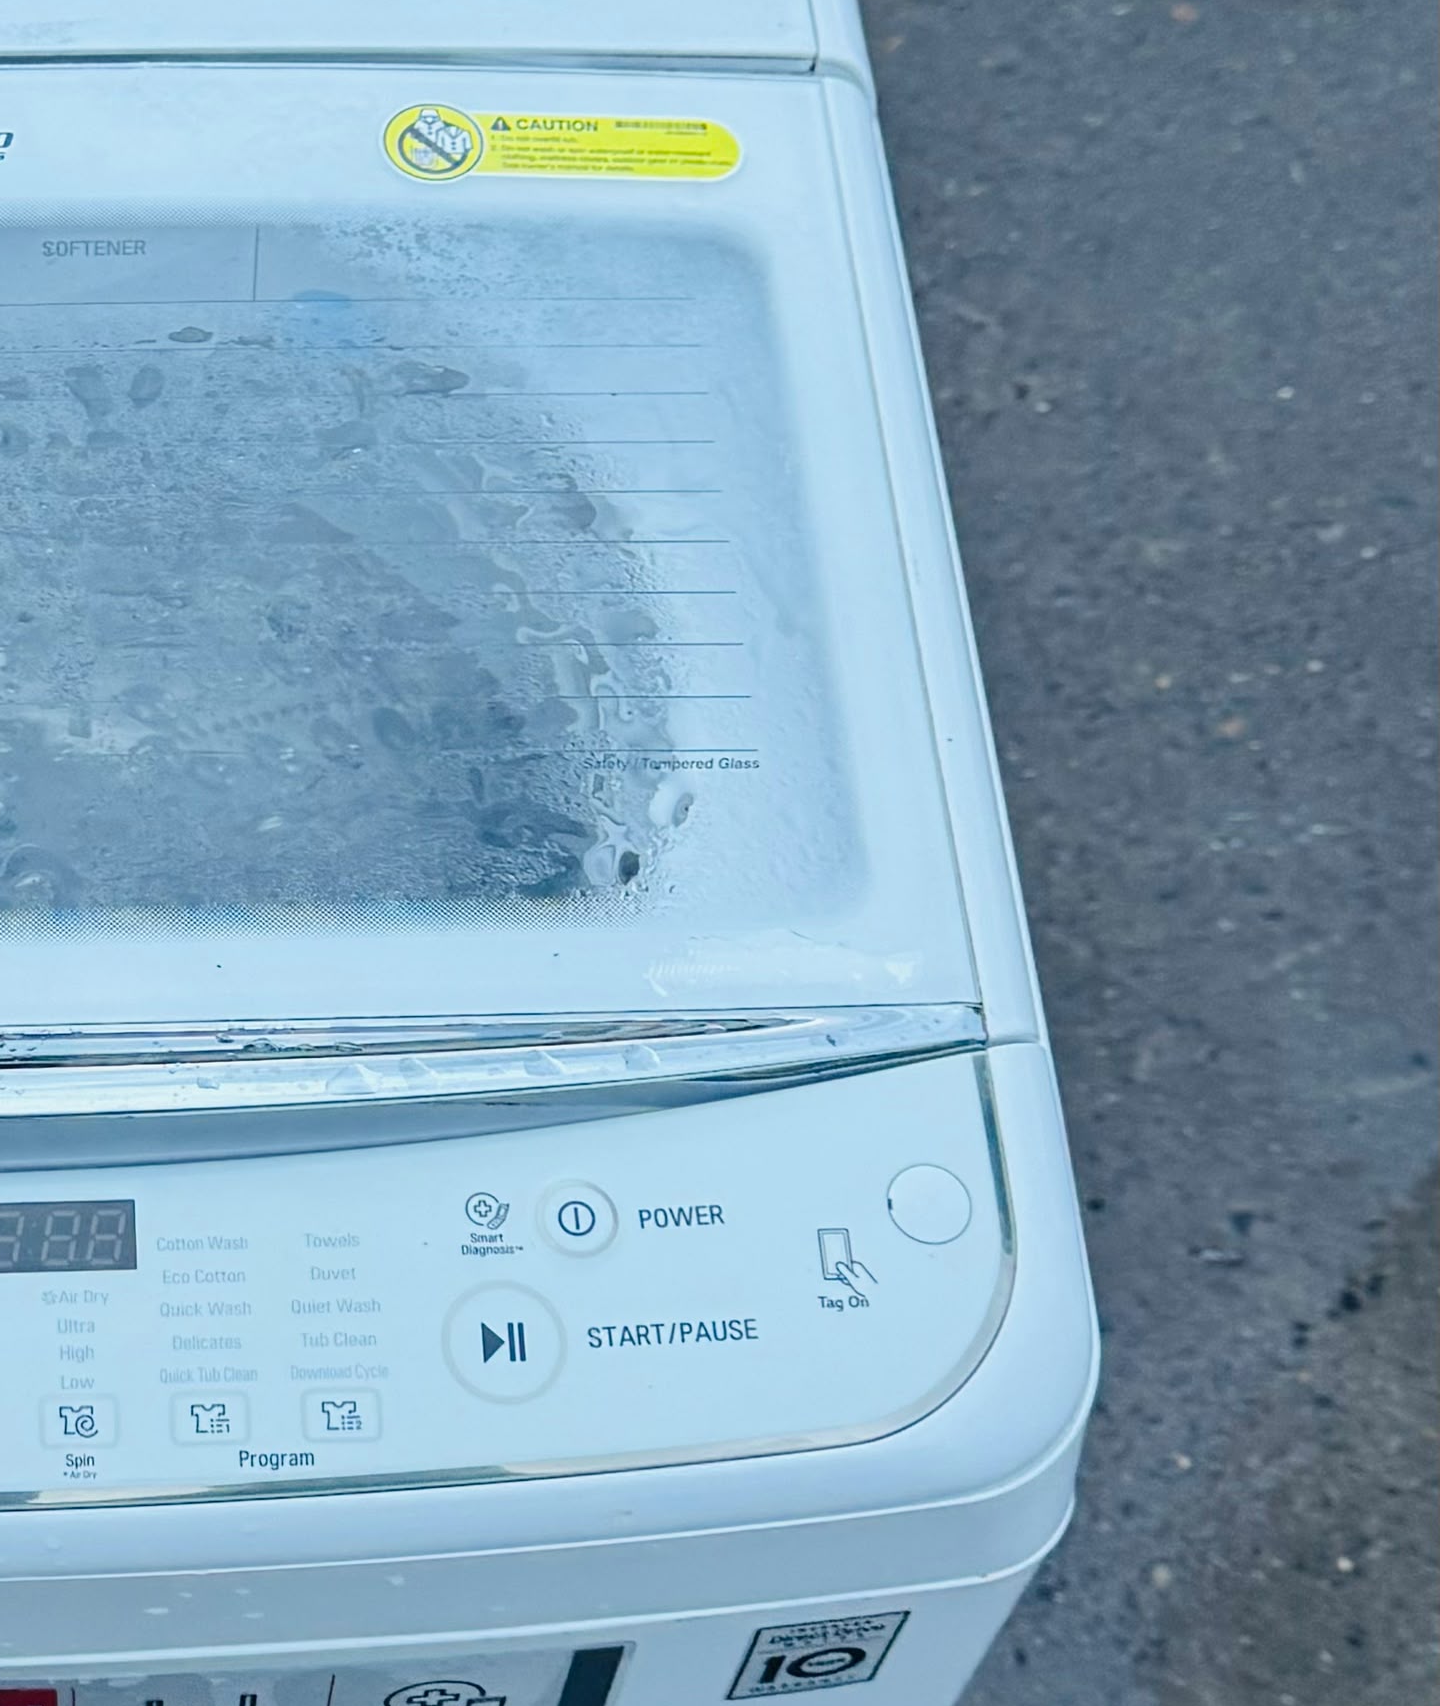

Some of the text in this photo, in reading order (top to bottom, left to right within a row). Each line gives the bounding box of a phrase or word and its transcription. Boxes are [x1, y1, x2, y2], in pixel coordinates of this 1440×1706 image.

[516, 119, 598, 132] CAUTION
[42, 240, 146, 257] SOFTENER
[642, 758, 713, 771] Tempered
[718, 757, 760, 769] Glass
[639, 1205, 724, 1229] POWER
[157, 1236, 248, 1252] Cotton Wash
[304, 1233, 360, 1248] Towels
[470, 1233, 503, 1243] Smart
[163, 1269, 246, 1284] Eco Cotton
[311, 1266, 356, 1281] Duvet
[84, 1290, 109, 1306] Dry
[817, 1295, 869, 1312] Tag On
[160, 1301, 252, 1318] Quick Wash
[291, 1298, 381, 1315] Quiet Wash
[58, 1318, 95, 1333] Ultra
[301, 1331, 377, 1349] Tub Clean
[588, 1319, 758, 1349] START/PAUSE
[172, 1335, 242, 1351] Delicates
[60, 1345, 94, 1362] High
[160, 1366, 258, 1384] Quick Tub Clean
[290, 1364, 388, 1381] Download Cycle
[60, 1375, 95, 1389] Low
[66, 1454, 95, 1469] Spin
[239, 1450, 314, 1470] Program
[83, 1470, 96, 1479] Dry
